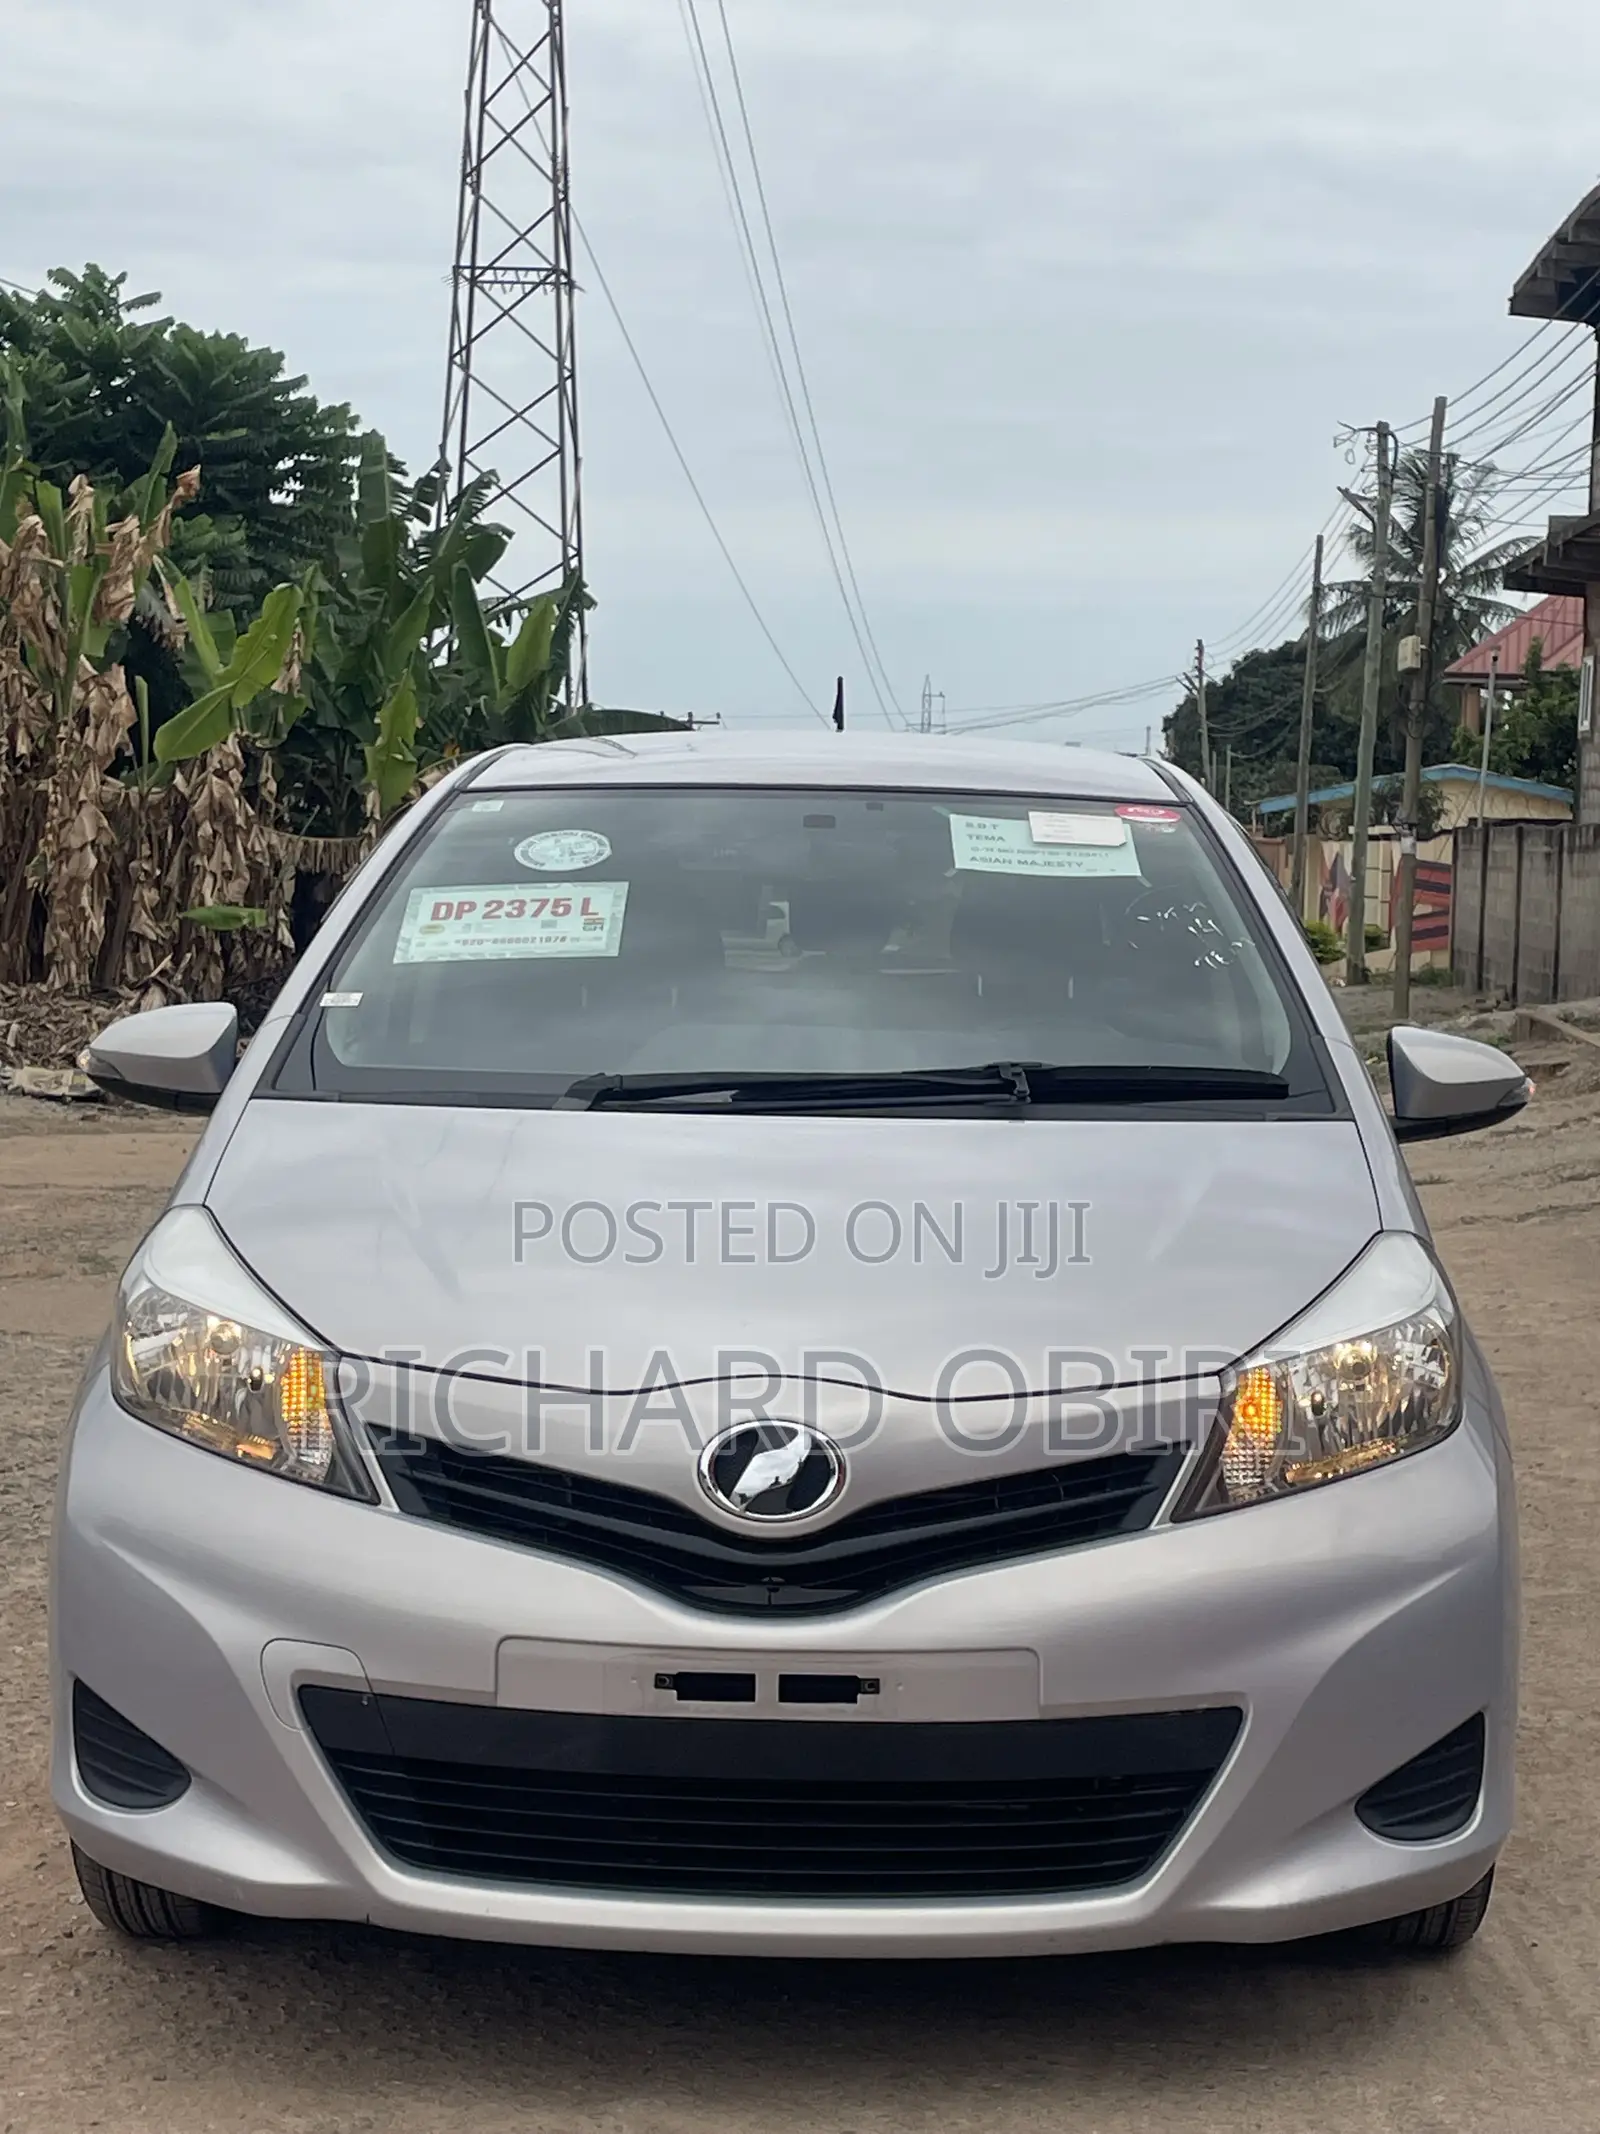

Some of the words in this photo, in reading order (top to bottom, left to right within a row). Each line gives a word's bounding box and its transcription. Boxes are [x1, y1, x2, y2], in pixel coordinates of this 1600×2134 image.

[966, 833, 1006, 843] TEMA
[969, 855, 1013, 866] ASIAN
[1017, 859, 1083, 868] MAJESTY
[430, 900, 477, 921] DP
[481, 897, 572, 920] 2375
[580, 897, 600, 916] L
